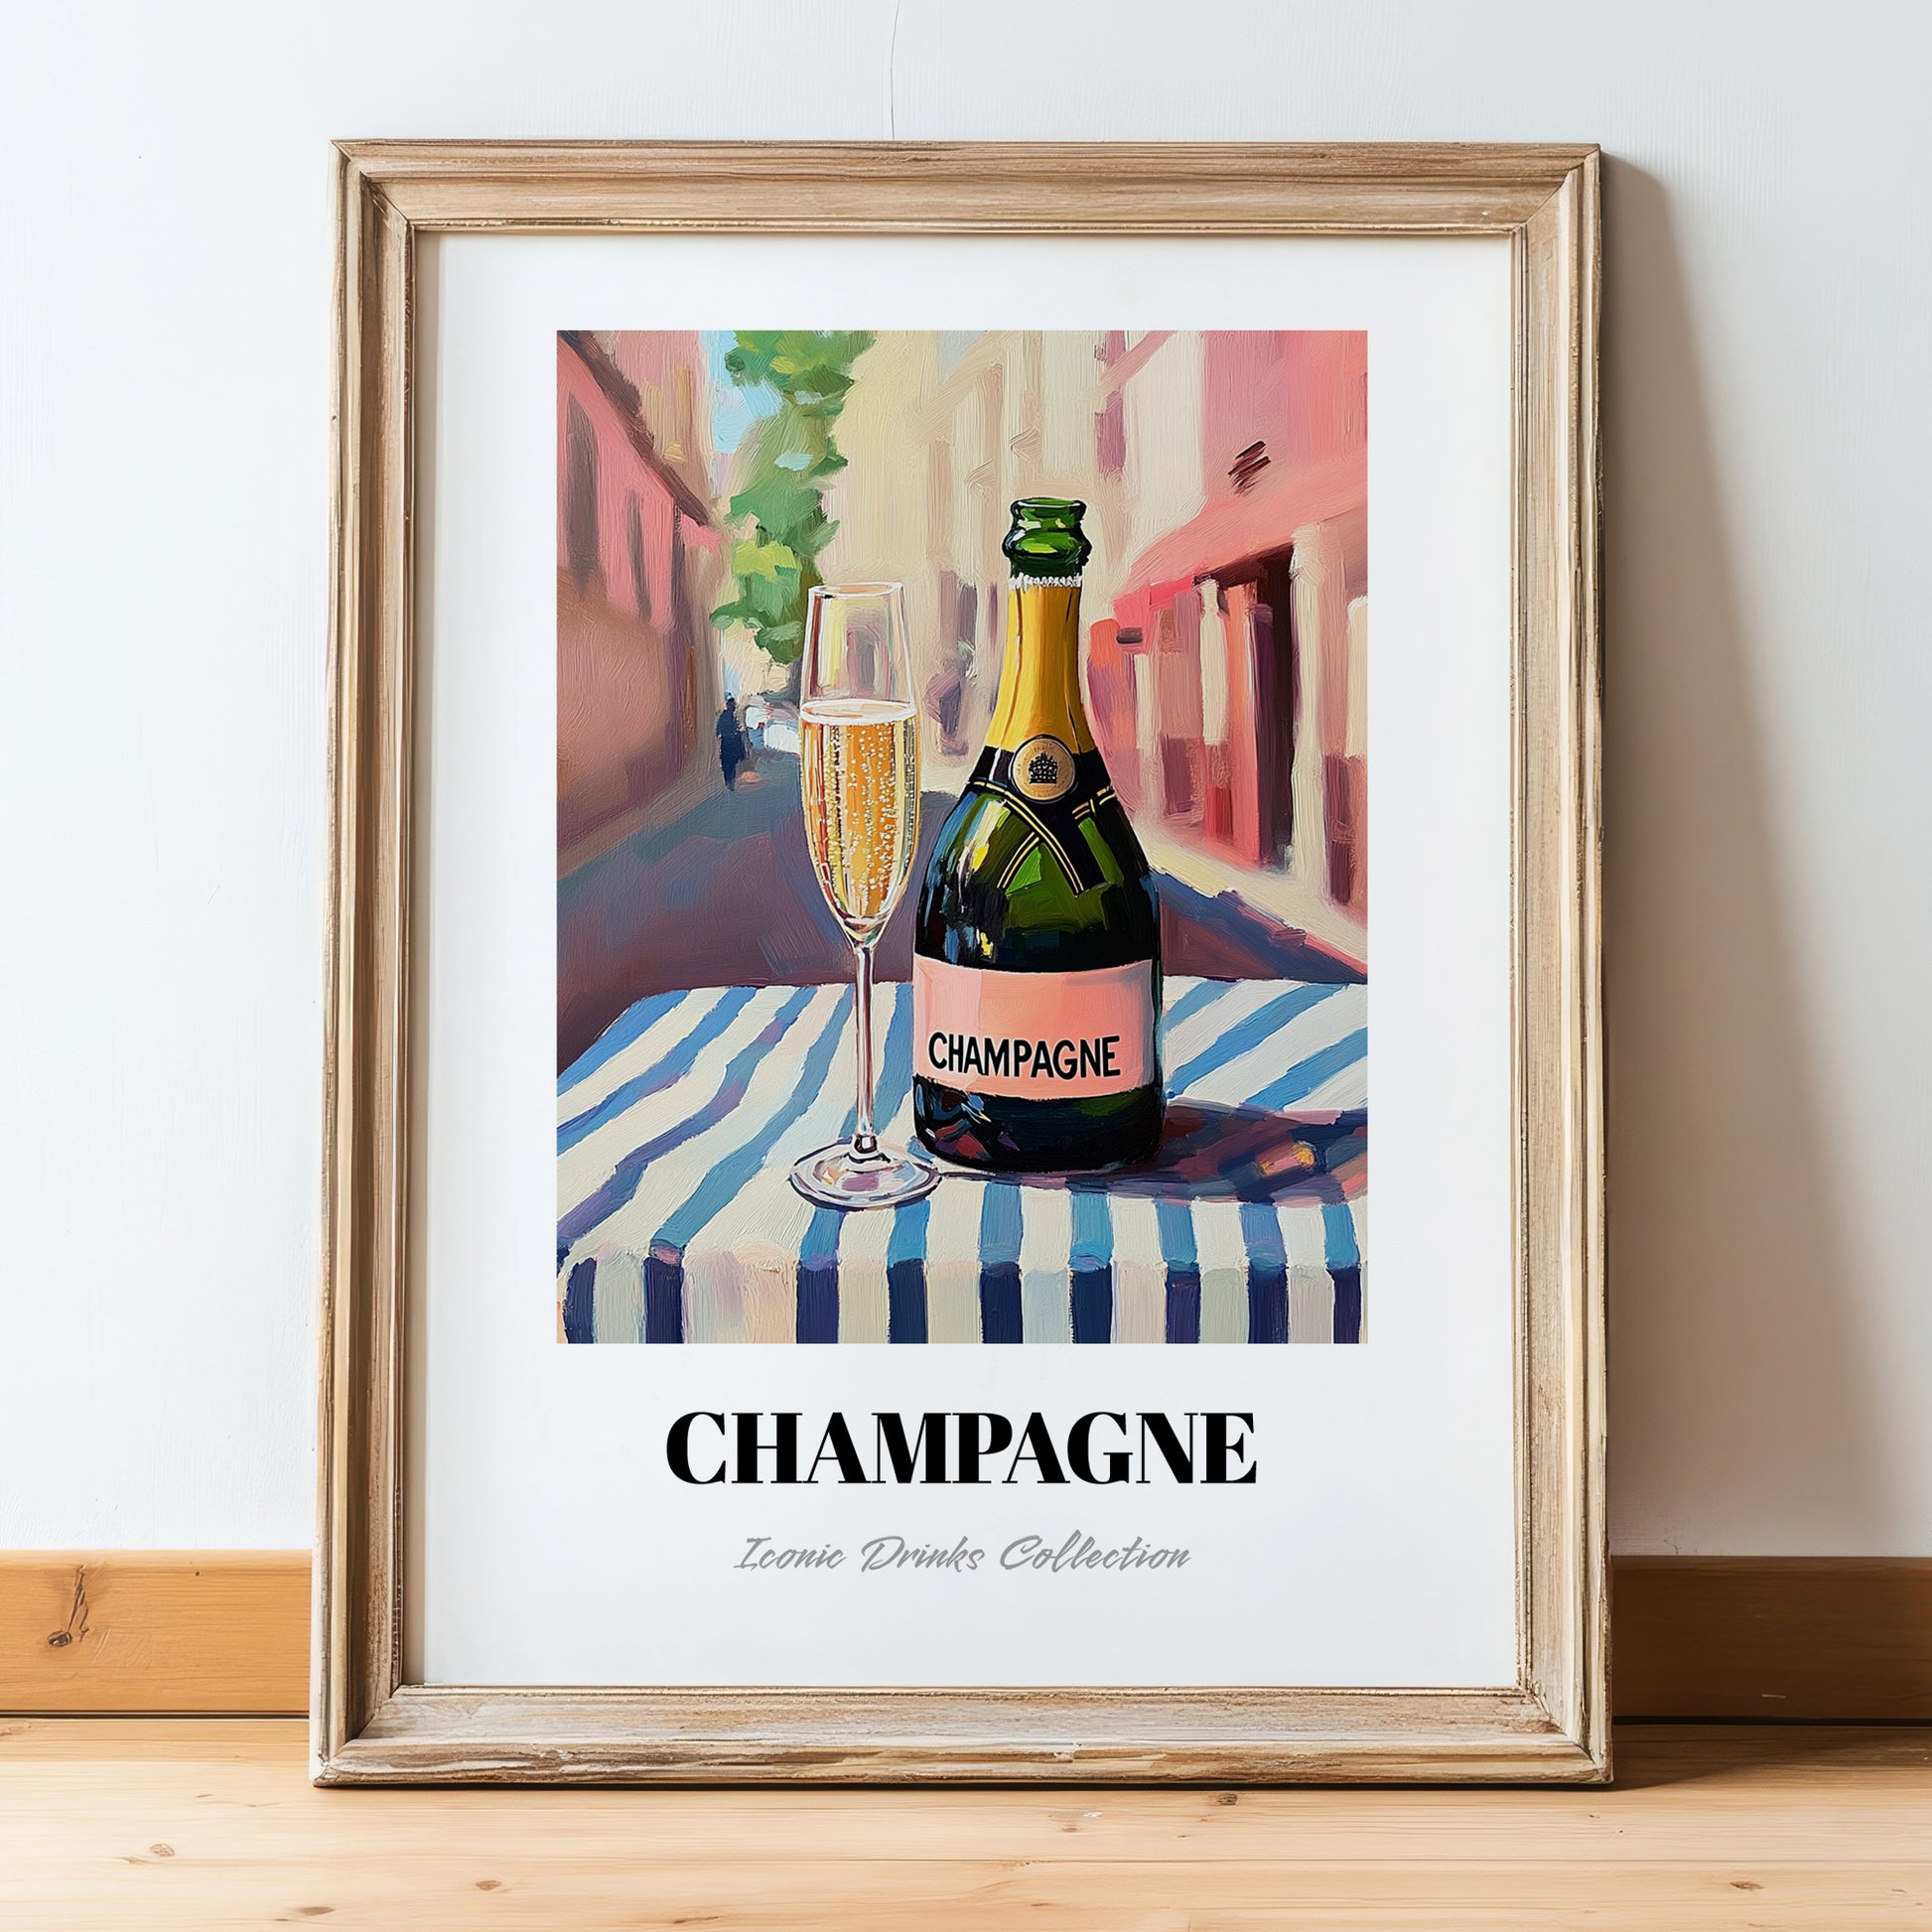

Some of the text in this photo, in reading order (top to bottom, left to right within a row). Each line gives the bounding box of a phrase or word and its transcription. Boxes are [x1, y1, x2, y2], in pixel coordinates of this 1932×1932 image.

[928, 1032, 1121, 1080] CHAMPAGNE
[666, 1412, 1257, 1484] CHAMPAGNE
[734, 1528, 1192, 1574] Iconic Drinks Collection
